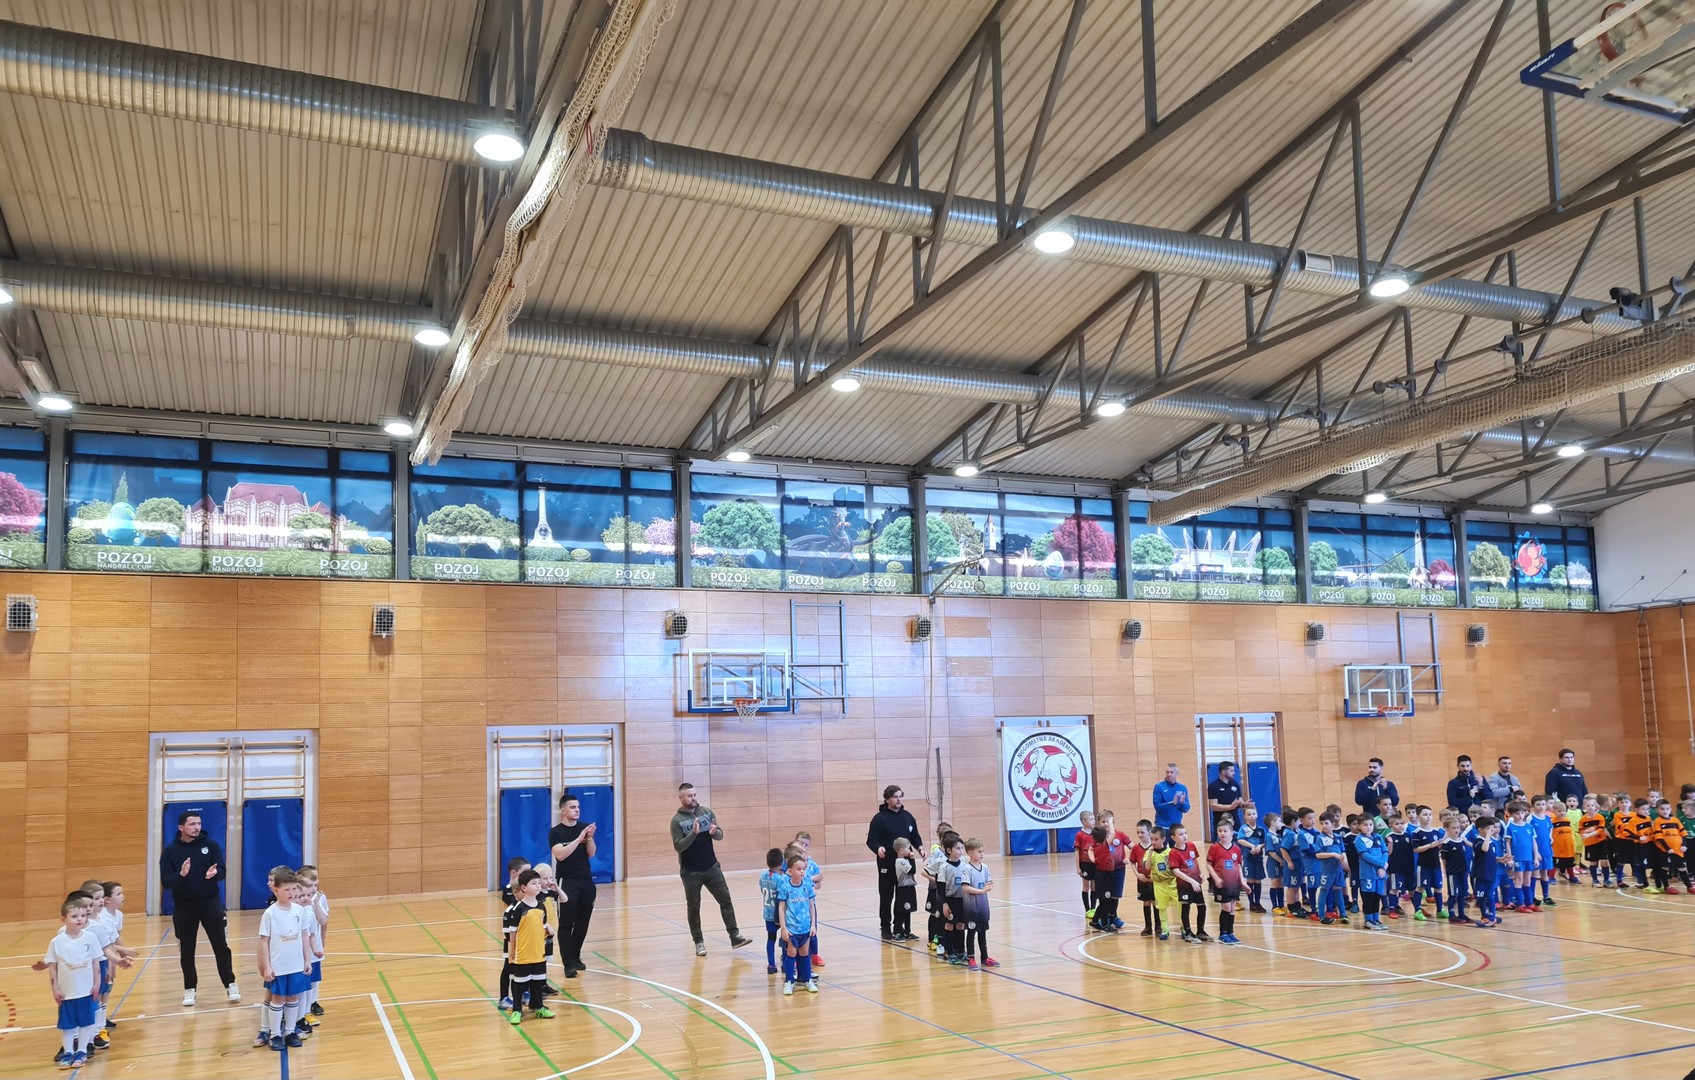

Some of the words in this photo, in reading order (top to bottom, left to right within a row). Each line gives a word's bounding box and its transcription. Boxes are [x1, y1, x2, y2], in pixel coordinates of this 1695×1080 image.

[97, 551, 152, 565] POZOJ
[212, 555, 263, 568] POZOJ
[320, 559, 368, 571] POZOJ
[434, 563, 479, 575] POZOJ
[527, 566, 570, 578] POZOJ
[615, 569, 655, 580] POZOJ
[710, 572, 748, 583] POZOJ
[788, 575, 824, 585] POZOJ
[863, 577, 896, 587] POZOJ
[943, 579, 975, 589] POZOJ
[1010, 581, 1040, 591] POZOJ
[1073, 583, 1103, 593] POZOJ
[1143, 585, 1171, 595] POZOJ
[1201, 587, 1229, 596] POZOJ
[1258, 589, 1285, 598] POZOJ
[1319, 590, 1345, 599] POZOJ
[1371, 592, 1396, 601] POZOJ
[1420, 593, 1445, 602] POZOJ
[1475, 595, 1499, 604] POZOJ
[1521, 597, 1544, 605] POZOJ
[1566, 598, 1587, 606] POZOJ
[1017, 736, 1048, 758] NOGOMETNA
[1048, 736, 1077, 758] AKADEMIJA
[1244, 866, 1249, 876] 5
[1290, 875, 1298, 886] 16
[1309, 875, 1316, 885] 9
[1365, 879, 1373, 890] 3
